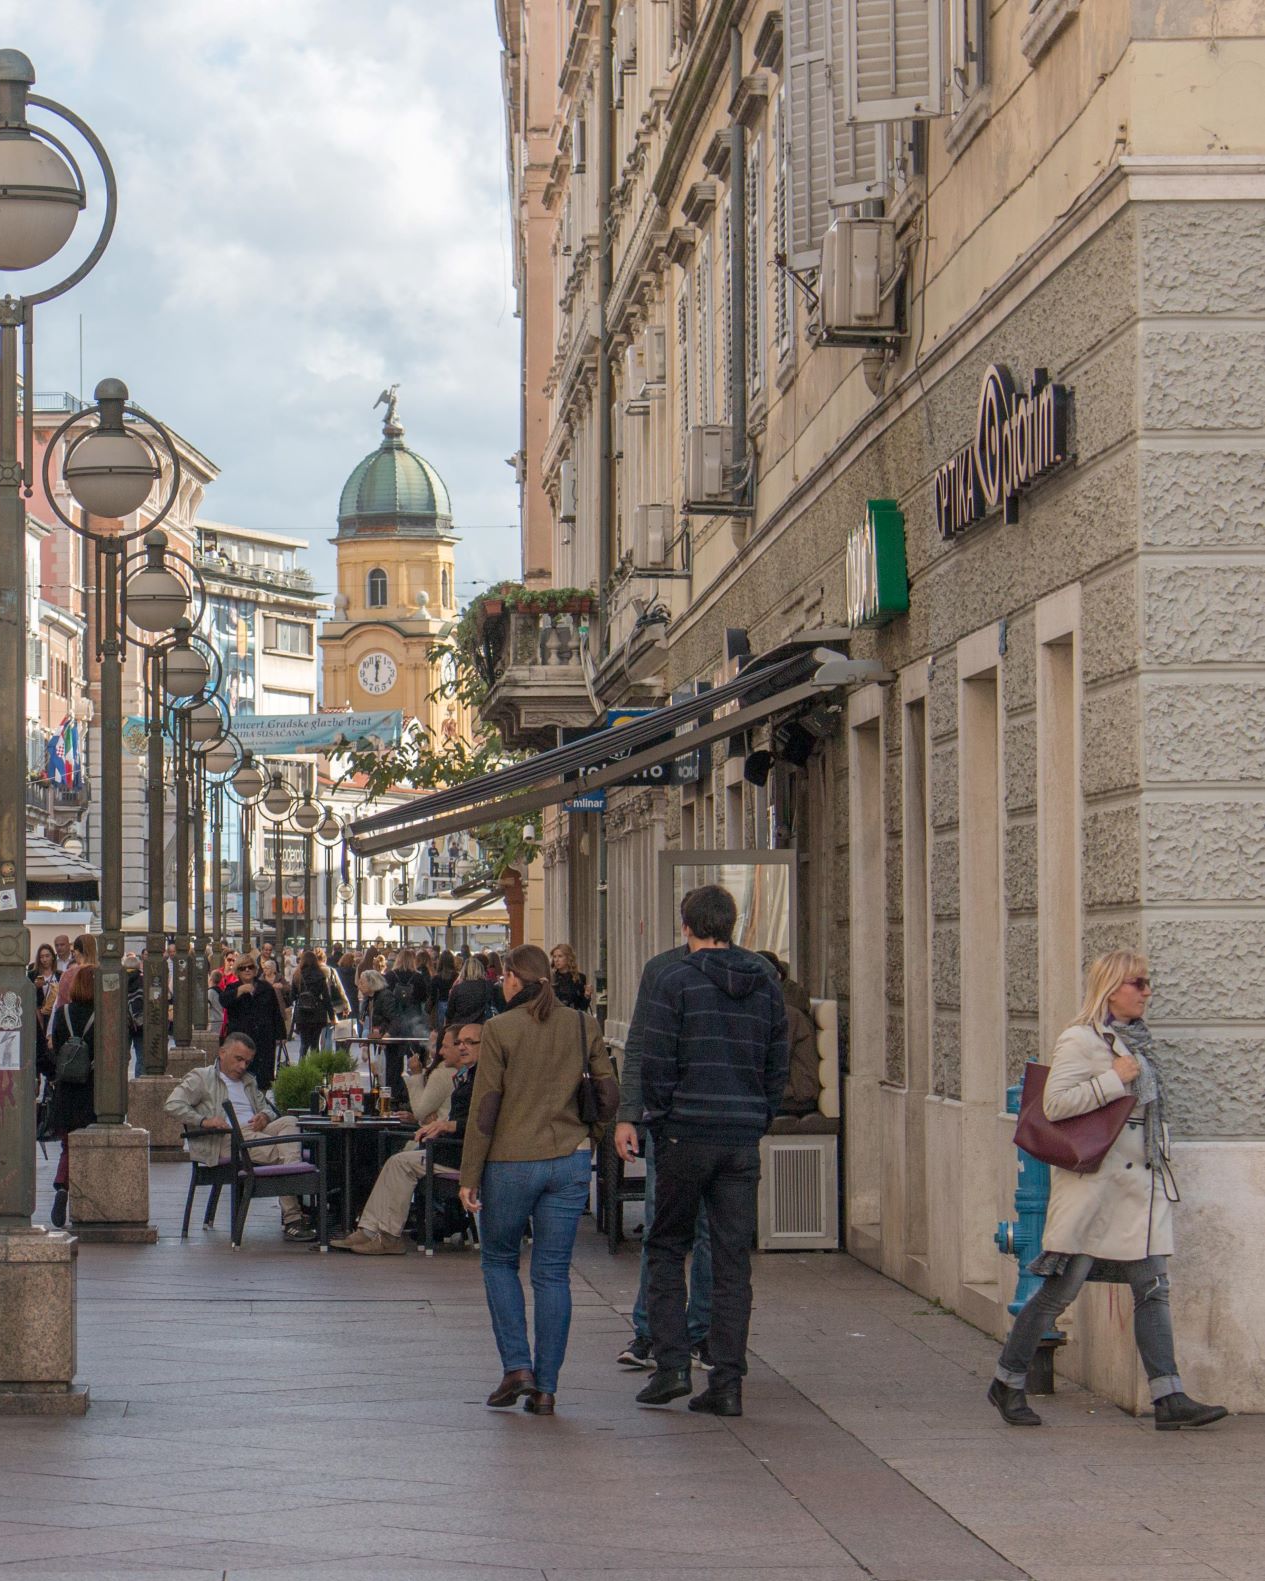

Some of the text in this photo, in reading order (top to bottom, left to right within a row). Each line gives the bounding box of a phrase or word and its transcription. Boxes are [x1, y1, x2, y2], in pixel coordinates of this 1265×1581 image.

[935, 446, 977, 538] OPTIKA
[267, 718, 309, 729] Gradske
[346, 716, 372, 727] Trsat
[573, 799, 604, 809] mlinar
